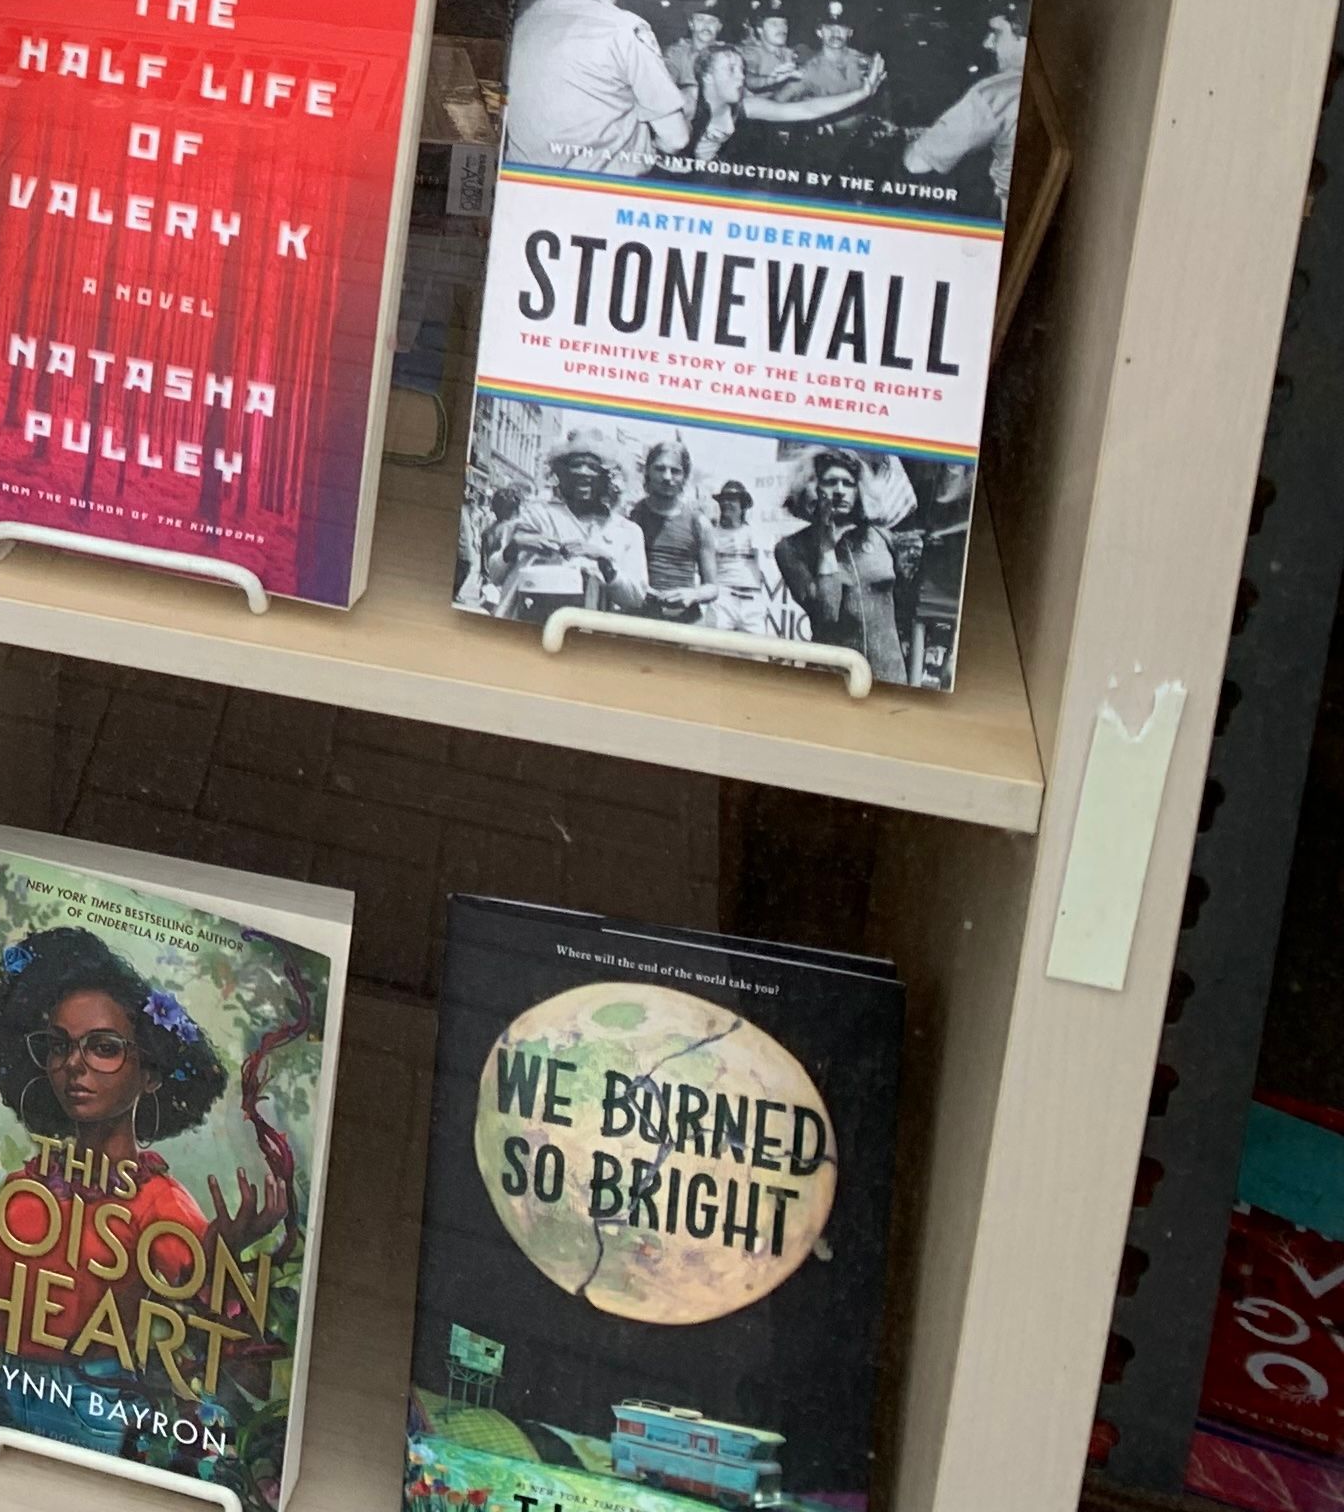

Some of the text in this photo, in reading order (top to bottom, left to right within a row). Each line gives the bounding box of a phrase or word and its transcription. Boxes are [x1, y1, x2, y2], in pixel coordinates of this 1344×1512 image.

[19, 35, 337, 118] HALF LIFE
[128, 123, 204, 166] OF
[10, 172, 313, 262] VALERY K
[617, 209, 873, 255] MARTIN DUBERMAN
[82, 276, 215, 319] A NOVEL
[518, 228, 961, 377] STONEWALL
[9, 333, 277, 419] NATASHA
[520, 332, 943, 401] THE DEFINITIVE STORY OF THE LGBTQ RIGHTS
[564, 361, 890, 416] UPRISING THAT CHANGED AMERICA
[24, 410, 243, 484] PULLEY
[26, 879, 244, 952] NEW YORK TIMES BESTSELLING AUTHOR
[67, 906, 200, 953] OF CINDERELLA IS DEAD
[497, 1048, 827, 1177] WE BURNED
[32, 1135, 138, 1197] THIS
[502, 1137, 799, 1257] SO BRIGHT
[88, 1392, 227, 1456] BAYRON
